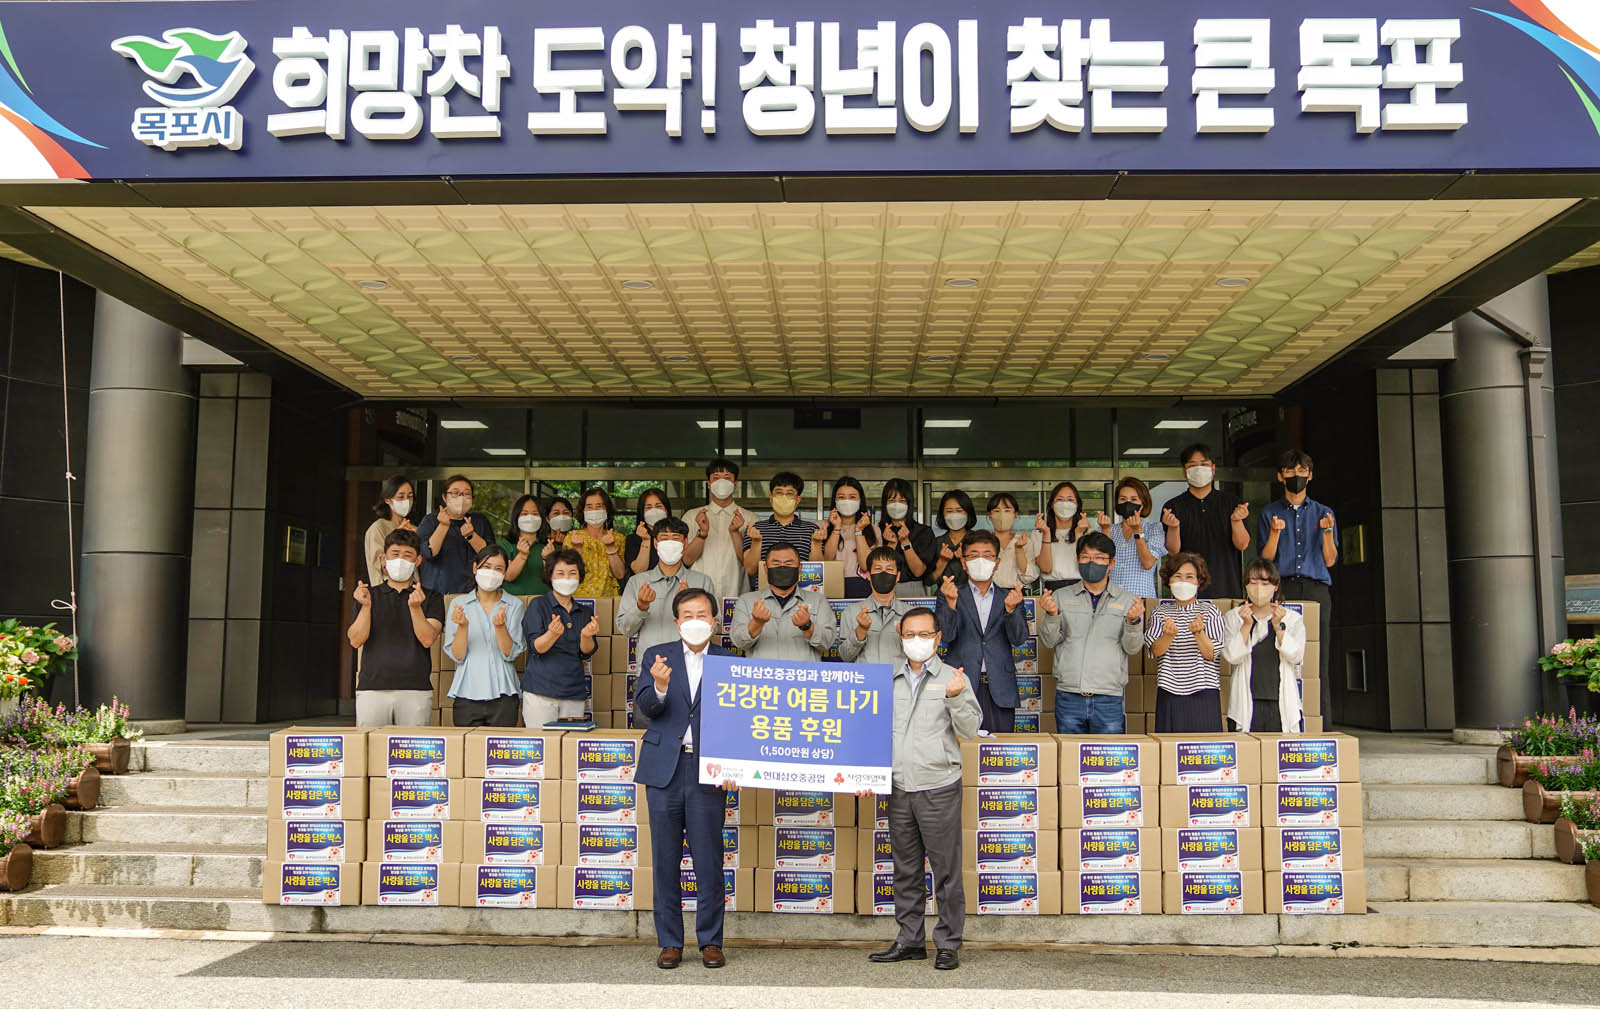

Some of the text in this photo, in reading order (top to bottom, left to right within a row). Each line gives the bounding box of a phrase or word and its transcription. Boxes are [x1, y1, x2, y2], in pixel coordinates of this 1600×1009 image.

[267, 17, 1469, 140] 희망찬 도약! 청년이 찾는 큰 목포
[136, 110, 234, 142] 목포시
[730, 665, 865, 683] 현대삼호중공업과 함께하는
[716, 682, 879, 714] 건강한 여름 나기
[750, 715, 842, 743] 용품 후원
[288, 748, 310, 758] 사랑을
[311, 748, 325, 758] 담은
[391, 749, 412, 758] 사랑을
[413, 750, 427, 759] 담은
[489, 749, 510, 759] 사랑을
[511, 750, 526, 759] 담은
[580, 752, 602, 762] 사랑을
[602, 753, 617, 762] 담은
[760, 745, 834, 760] (1,500만원 상당)
[1281, 753, 1303, 762] 사랑을
[1304, 753, 1318, 762] 담은
[982, 757, 1003, 766] 사랑을
[1005, 757, 1019, 766] 담은
[1082, 756, 1104, 766] 사랑을
[1106, 757, 1120, 766] 담은
[1179, 755, 1202, 765] 사랑을
[1203, 755, 1217, 764] 담은
[763, 770, 826, 784] 현대삼호중공업
[286, 790, 307, 800] 사랑을
[308, 791, 322, 800] 담은
[394, 791, 415, 801] 사랑을
[416, 792, 431, 801] 담은
[484, 793, 506, 802] 사랑을
[507, 794, 521, 803] 담은
[580, 795, 602, 805] 사랑을
[603, 796, 618, 805] 담은
[777, 797, 799, 807] 사랑을
[800, 797, 815, 807] 담은
[981, 801, 1003, 811] 사랑을
[1004, 801, 1018, 810] 담은
[1085, 798, 1107, 809] 사랑을
[1108, 798, 1123, 808] 담은
[1191, 798, 1214, 808] 사랑을
[1215, 798, 1230, 808] 담은
[1281, 797, 1303, 807] 사랑을
[1304, 797, 1319, 807] 담은
[289, 833, 310, 843] 사랑을
[311, 834, 326, 843] 담은
[387, 834, 408, 843] 사랑을
[409, 834, 423, 843] 담은
[487, 837, 509, 846] 사랑을
[510, 837, 524, 846] 담은
[582, 837, 603, 847] 사랑을
[604, 838, 619, 847] 담은
[778, 840, 800, 850] 사랑을
[802, 840, 816, 850] 담은
[877, 843, 892, 854] 사랑
[979, 844, 1002, 853] 사랑을
[1003, 844, 1018, 853] 담은
[1083, 842, 1105, 851] 사랑을
[1106, 842, 1121, 851] 담은
[1181, 842, 1203, 852] 사랑을
[1204, 842, 1219, 851] 담은
[1284, 842, 1306, 851] 사랑을
[1307, 841, 1322, 851] 담은
[284, 876, 306, 886] 사랑을
[307, 877, 321, 886] 담은
[382, 876, 404, 886] 사랑을
[405, 877, 419, 886] 담은
[479, 878, 502, 889] 사랑을
[503, 879, 518, 888] 담은
[577, 879, 599, 890] 사랑을
[600, 880, 614, 890] 담은
[776, 883, 798, 893] 사랑을
[799, 884, 814, 894] 담은
[980, 885, 1003, 895] 사랑을
[1004, 886, 1018, 895] 담은
[1083, 885, 1105, 895] 사랑을
[1106, 885, 1121, 894] 담은
[1185, 885, 1207, 895] 사랑을
[1208, 885, 1223, 894] 담은
[1285, 885, 1308, 894] 사랑을
[1309, 885, 1324, 894] 담은
